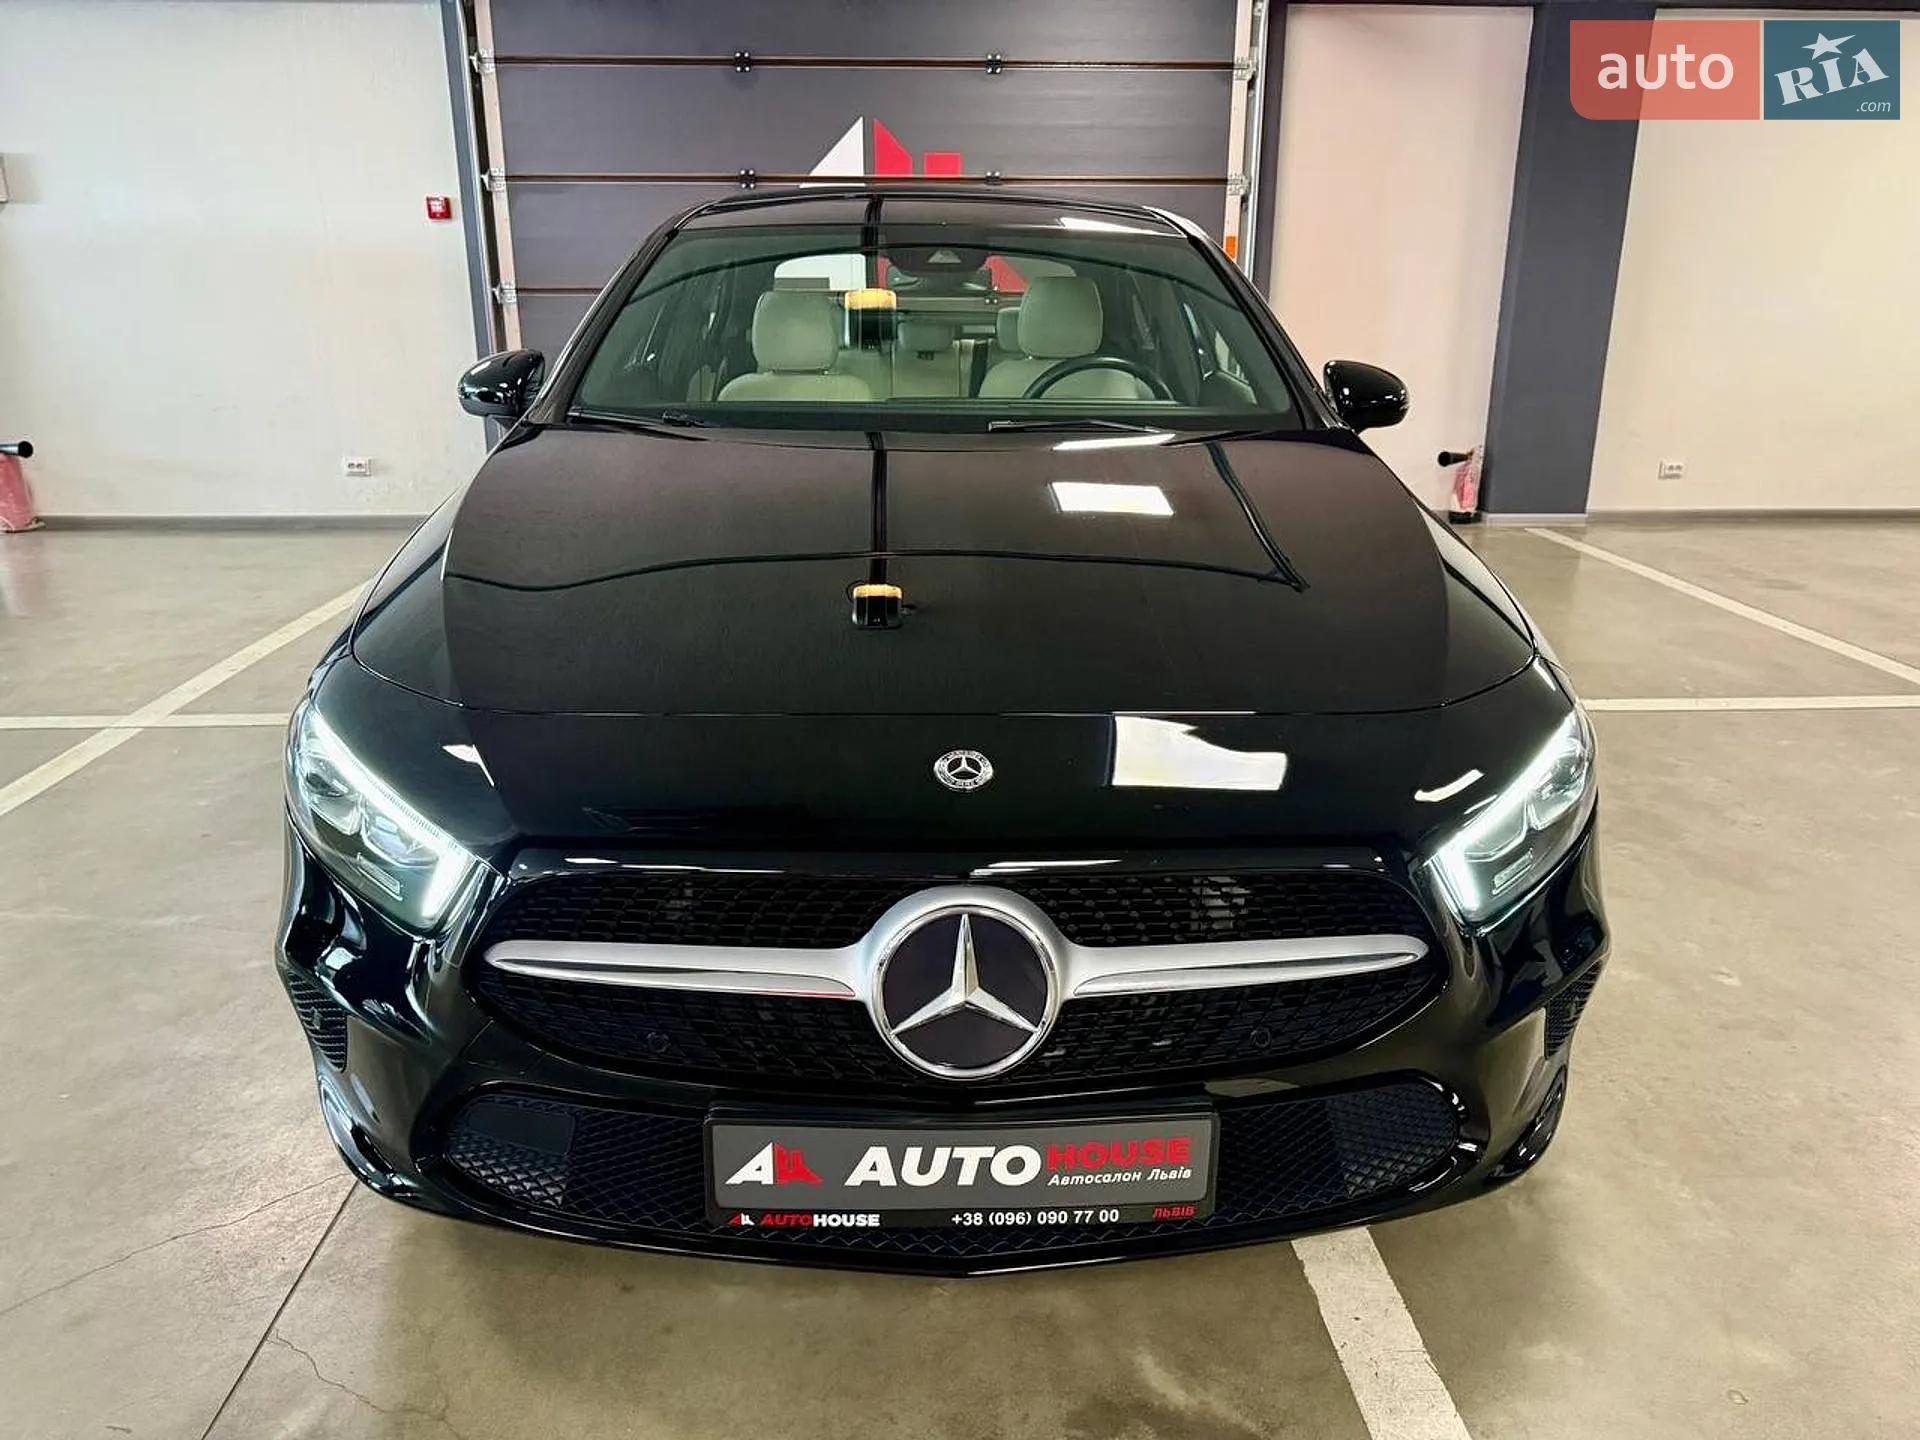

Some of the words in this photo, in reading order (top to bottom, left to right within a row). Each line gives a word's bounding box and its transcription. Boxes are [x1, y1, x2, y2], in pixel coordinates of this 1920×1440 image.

[843, 1145, 1042, 1187] AUTO
[1046, 1137, 1193, 1172] HOUSE
[1047, 1172, 1143, 1186] Автосалон
[1147, 1166, 1193, 1181] Львів
[761, 1213, 881, 1227] AUTOHOUSE
[951, 1211, 984, 1226] +38
[988, 1211, 1032, 1225] (096)
[1037, 1210, 1068, 1224] 090
[1073, 1210, 1095, 1224] 77
[1099, 1208, 1120, 1223] 00
